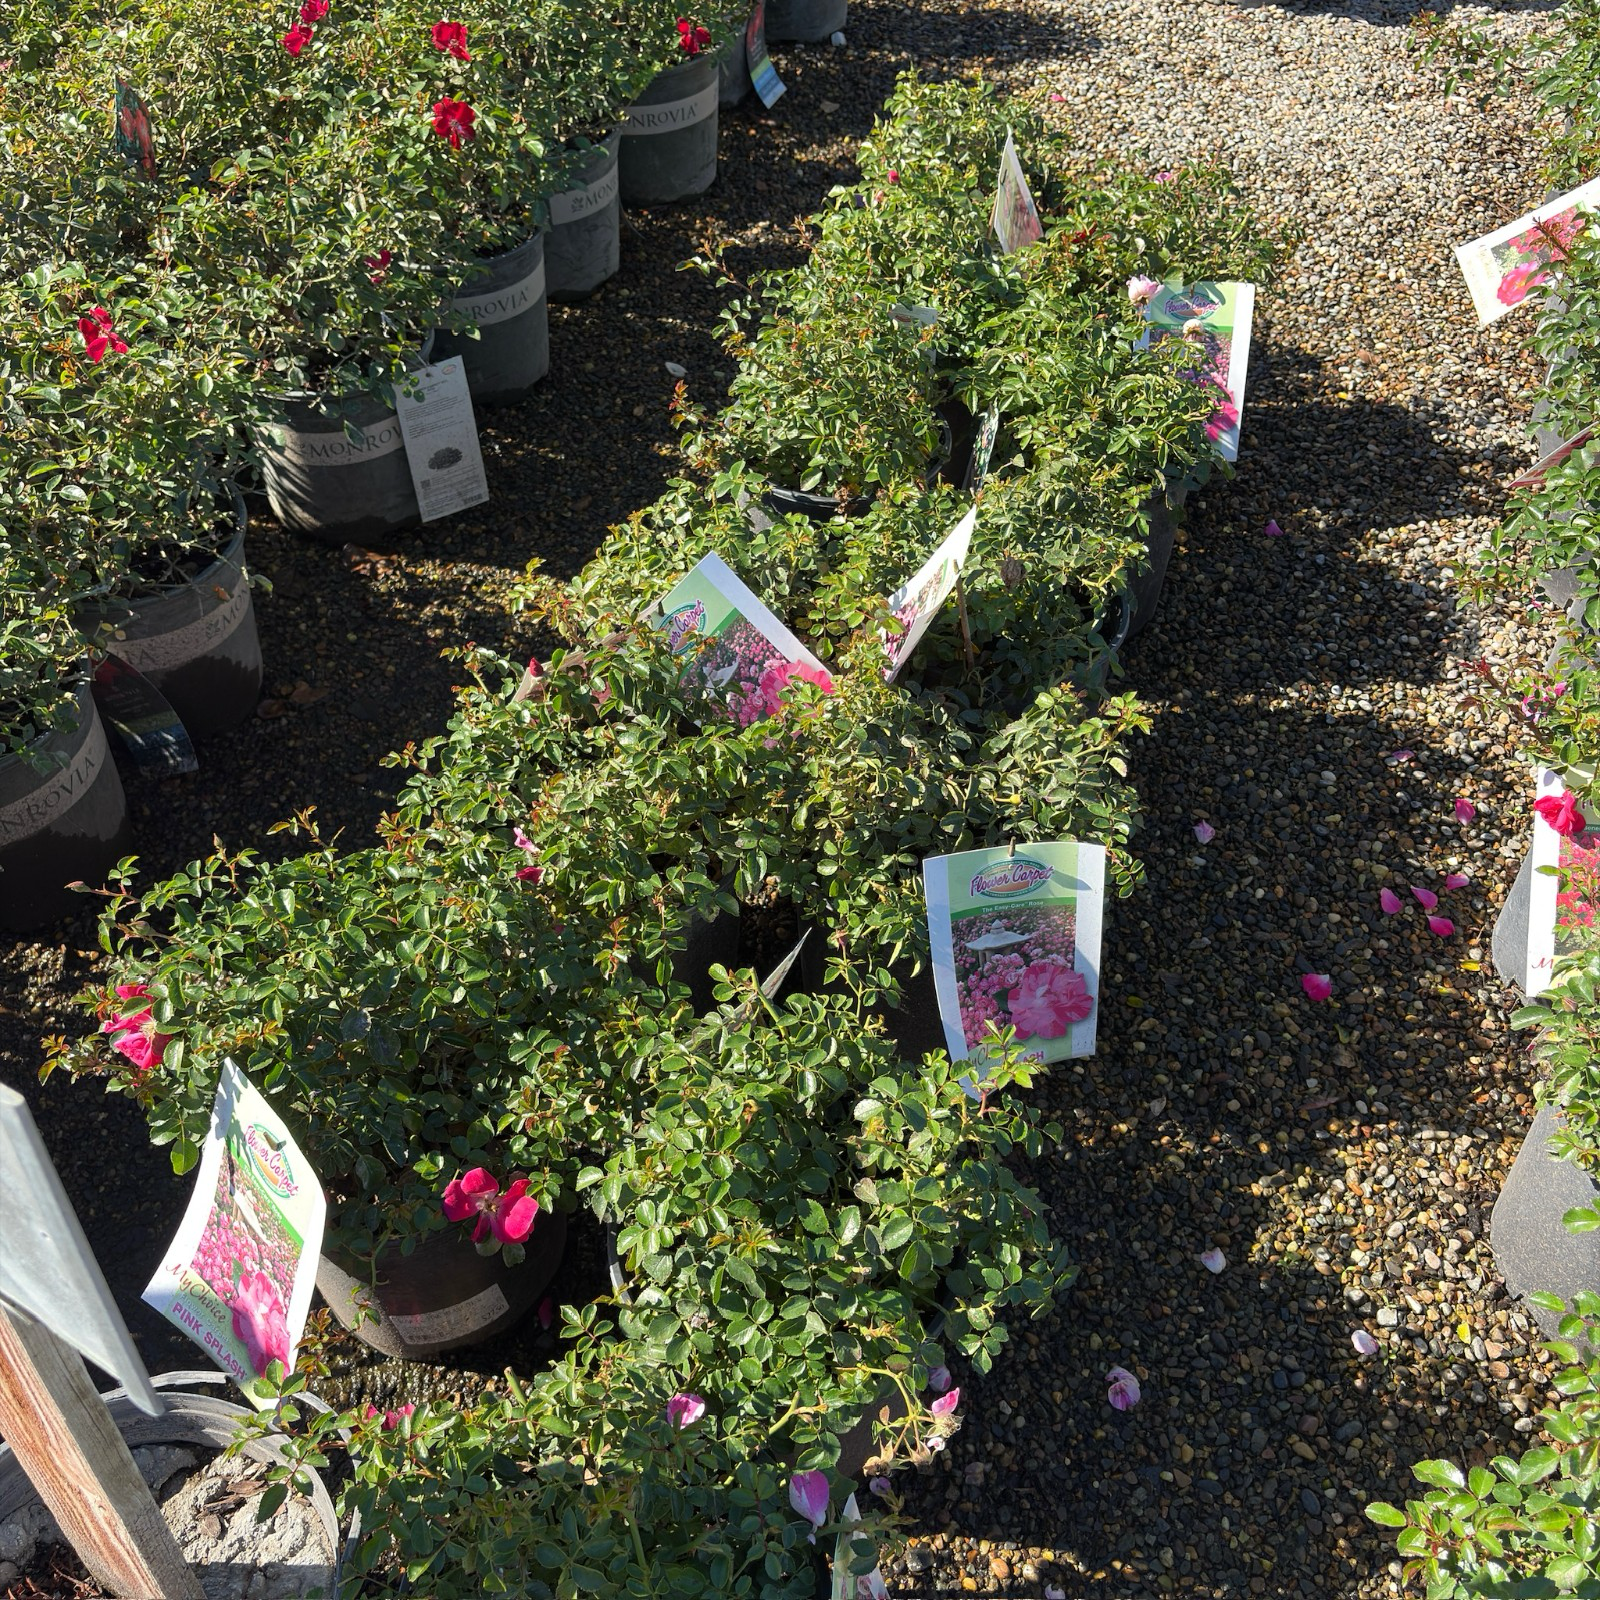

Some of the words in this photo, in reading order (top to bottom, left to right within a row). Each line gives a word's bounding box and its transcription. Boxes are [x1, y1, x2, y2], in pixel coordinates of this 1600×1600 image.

[1164, 300, 1191, 315] Flower
[674, 599, 704, 631] Carpet
[970, 872, 1011, 897] Flower
[1012, 863, 1055, 887] Carpet
[269, 1153, 299, 1196] Carpet
[171, 1301, 203, 1335] PINK
[203, 1331, 247, 1380] SPLASH
